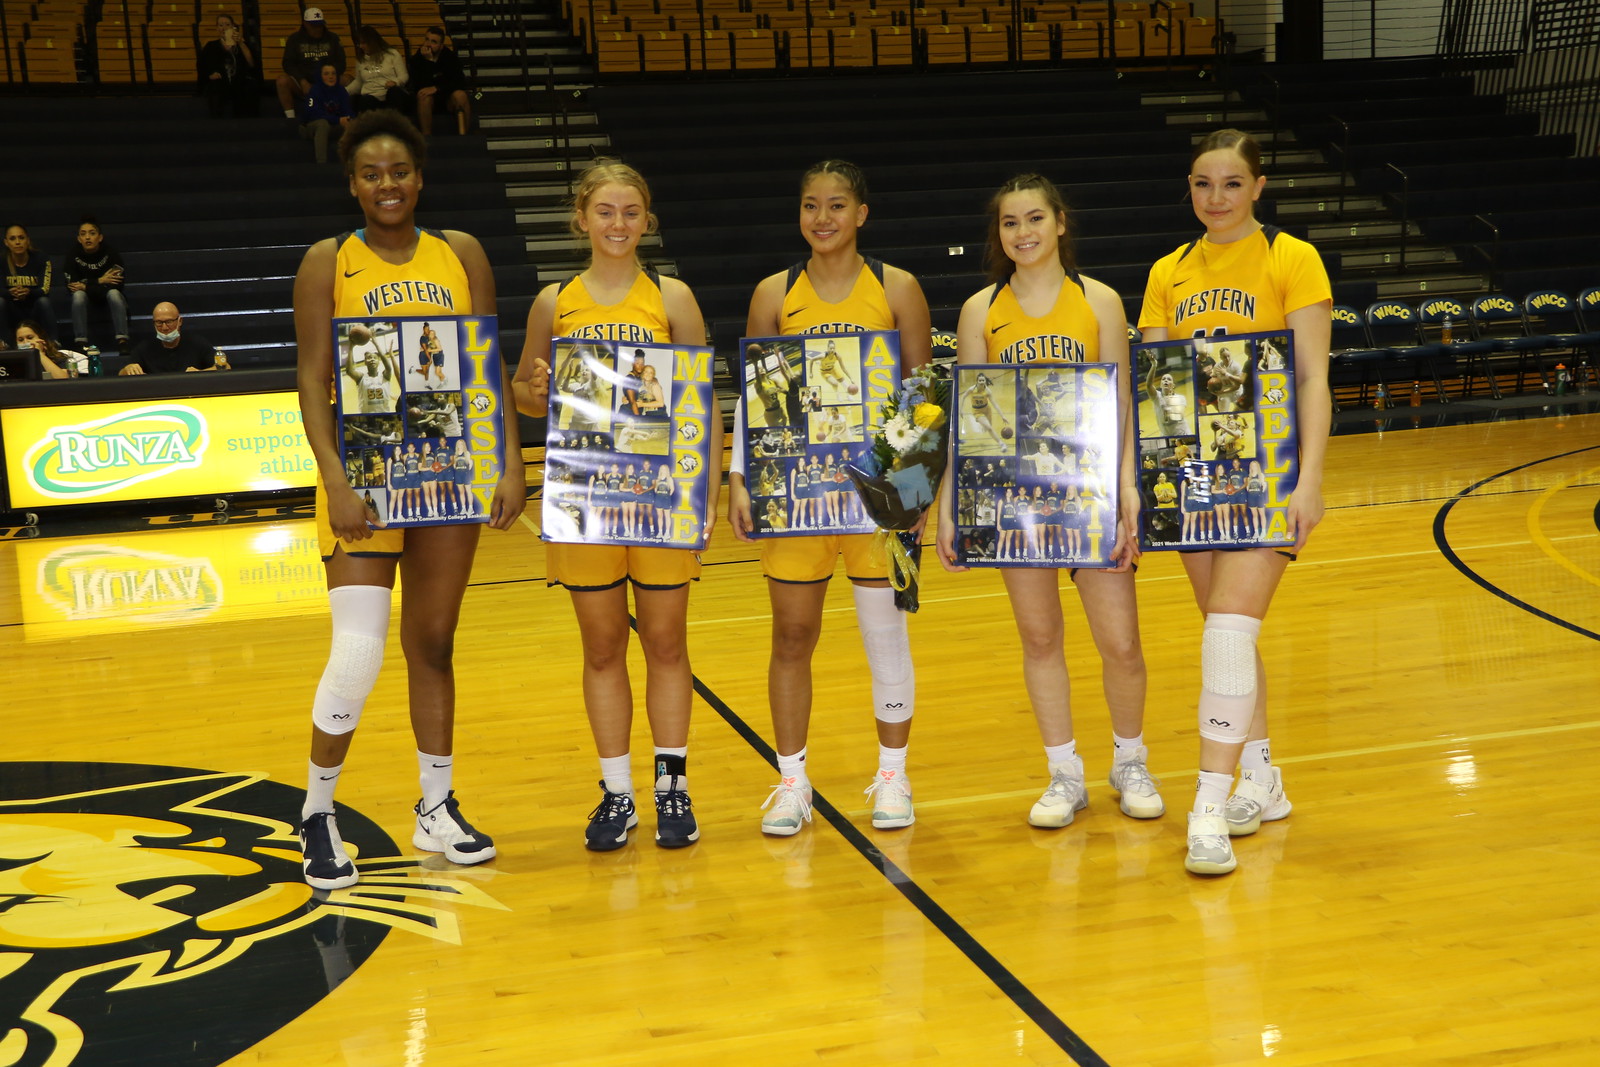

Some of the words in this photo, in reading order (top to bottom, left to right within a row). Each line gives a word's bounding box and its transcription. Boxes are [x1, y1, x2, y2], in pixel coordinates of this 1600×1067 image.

[363, 281, 455, 316] WESTERN
[1174, 287, 1257, 327] WESTERN
[1425, 300, 1462, 316] WNCC
[1478, 297, 1515, 313] WNCC
[1530, 294, 1568, 309] WNCC
[1331, 308, 1357, 324] NCC
[1373, 304, 1411, 320] WNCC
[930, 334, 958, 350] NCC
[999, 334, 1085, 364] WESTERN
[367, 387, 384, 401] 52
[464, 320, 500, 514] LIDSEY
[54, 430, 197, 474] RUNZA
[670, 350, 712, 544] MADDIE
[1257, 372, 1296, 542] BELLA
